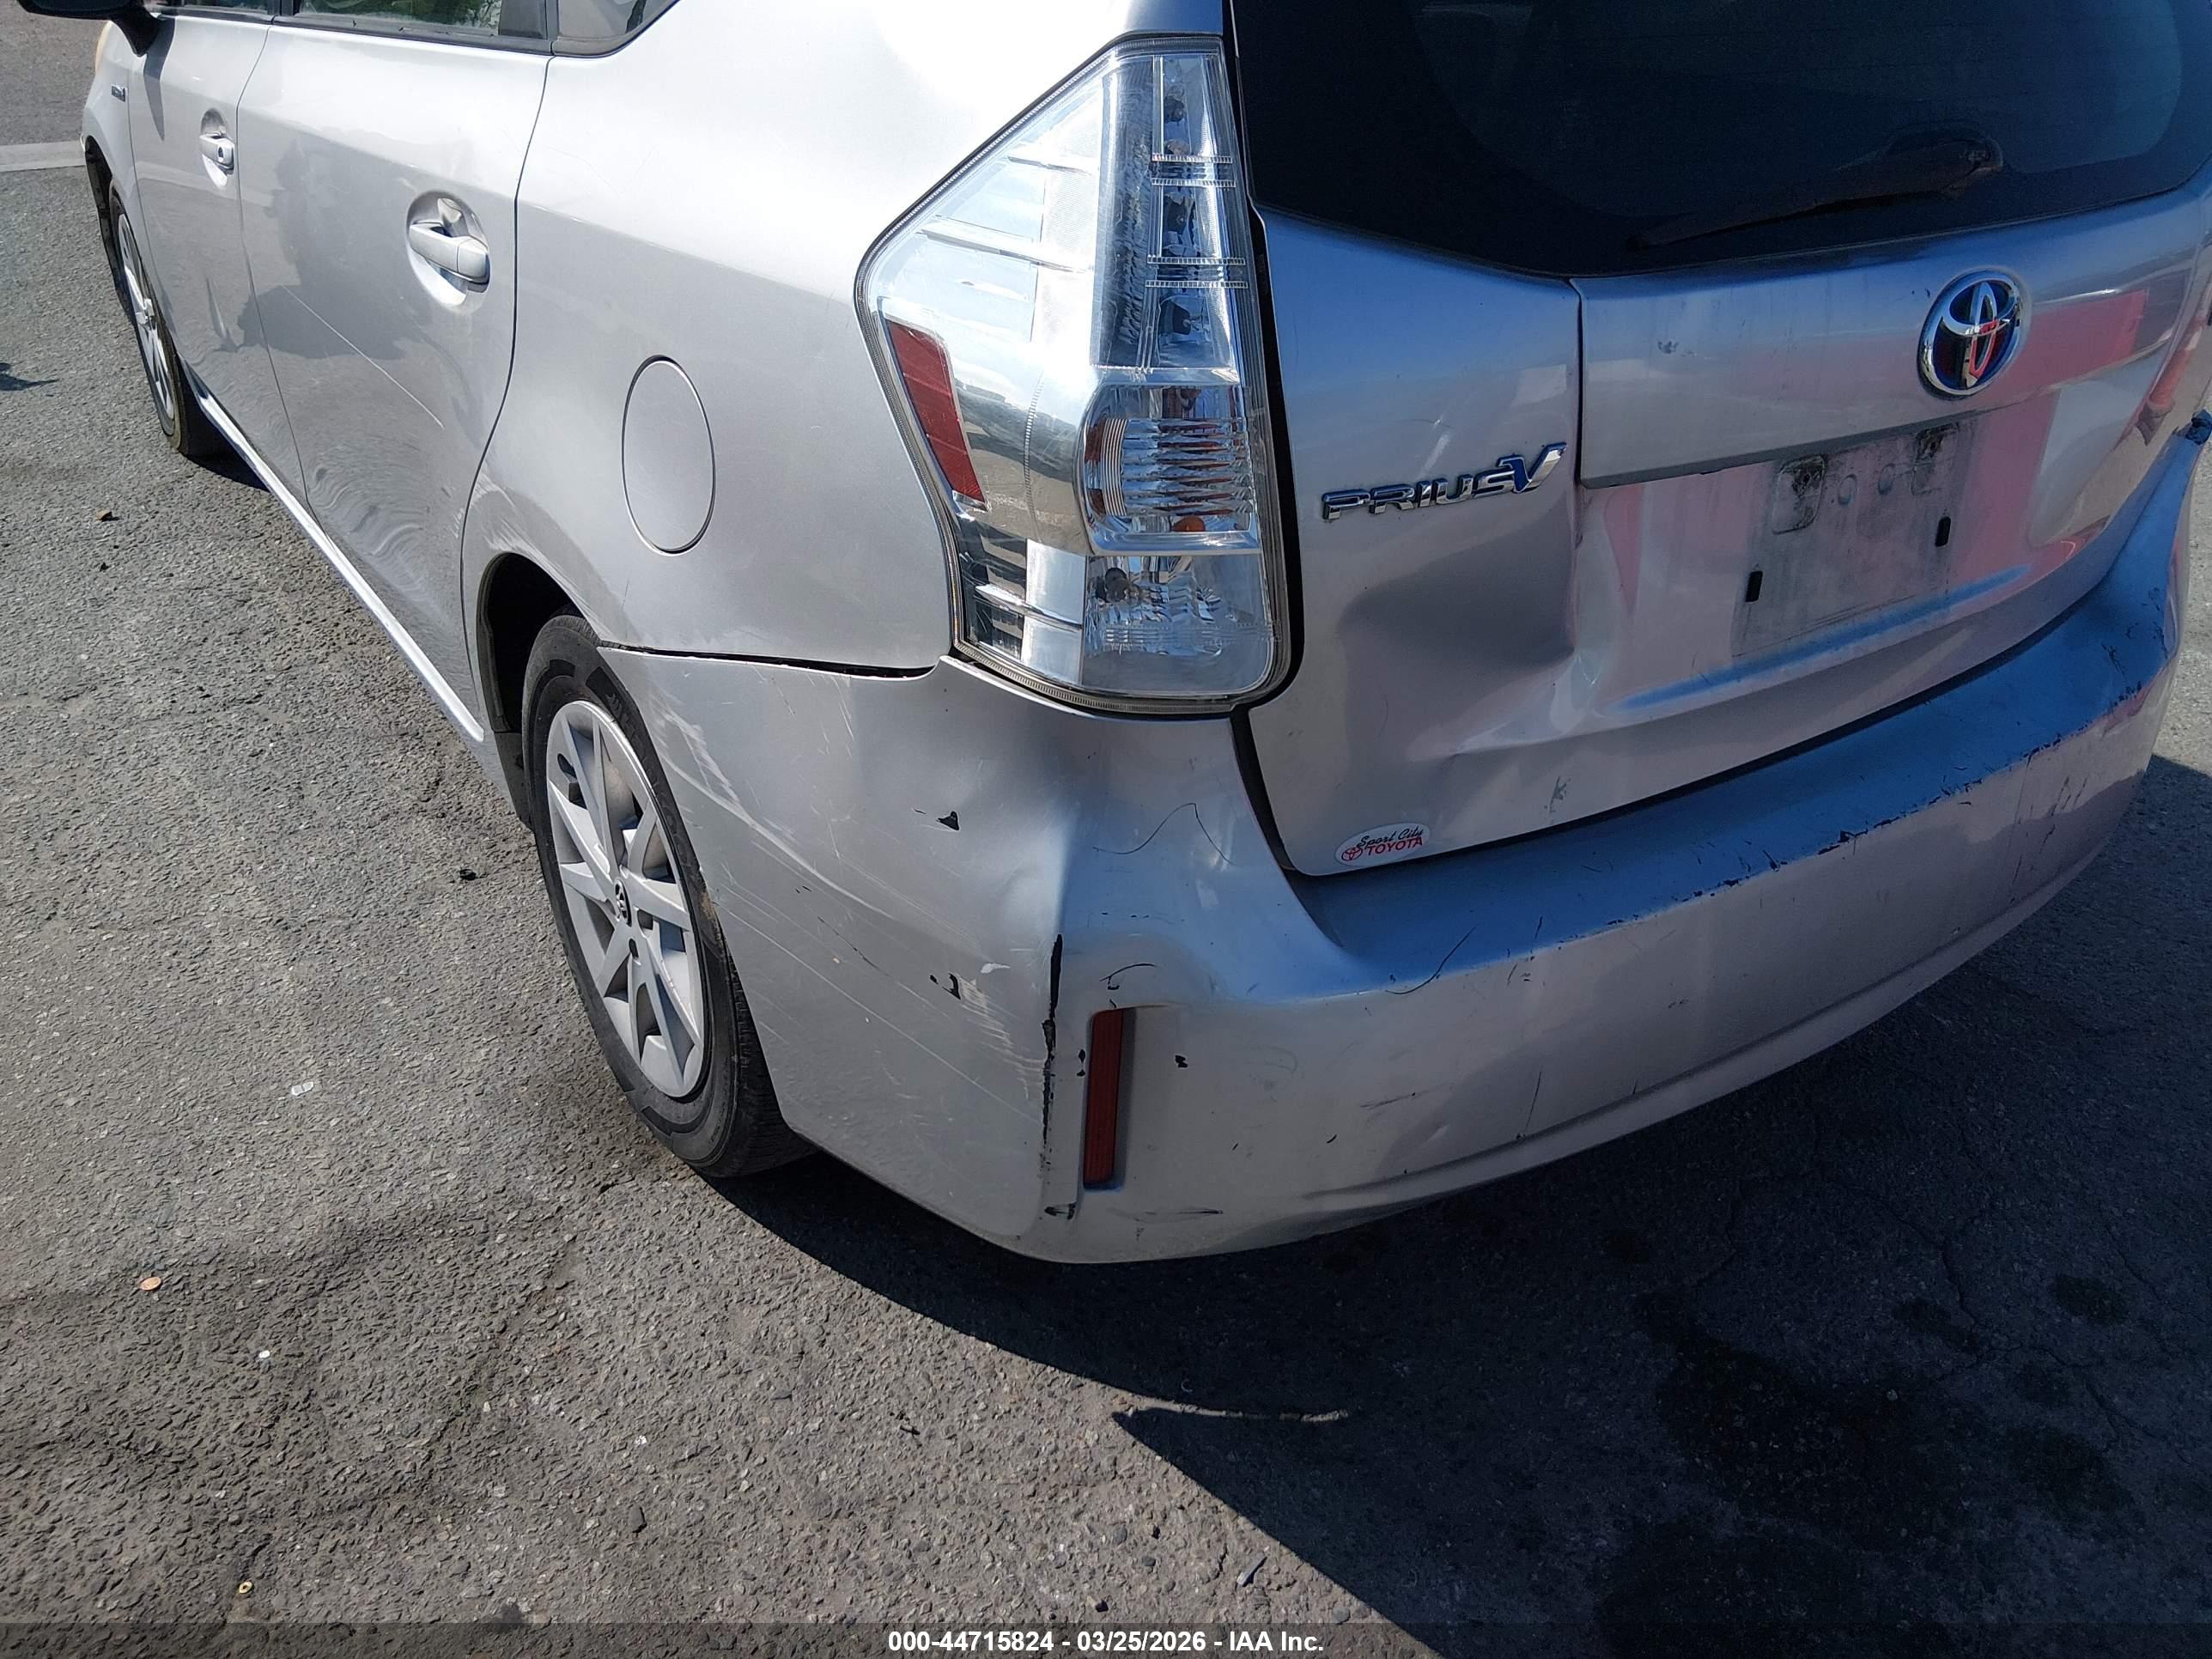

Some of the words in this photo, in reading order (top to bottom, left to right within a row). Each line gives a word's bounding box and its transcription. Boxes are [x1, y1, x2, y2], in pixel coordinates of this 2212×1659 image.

[1322, 467, 1515, 520] PRIUS
[1357, 830, 1397, 849] Sport
[1398, 826, 1424, 841] City
[1368, 836, 1424, 856] TOYOTA
